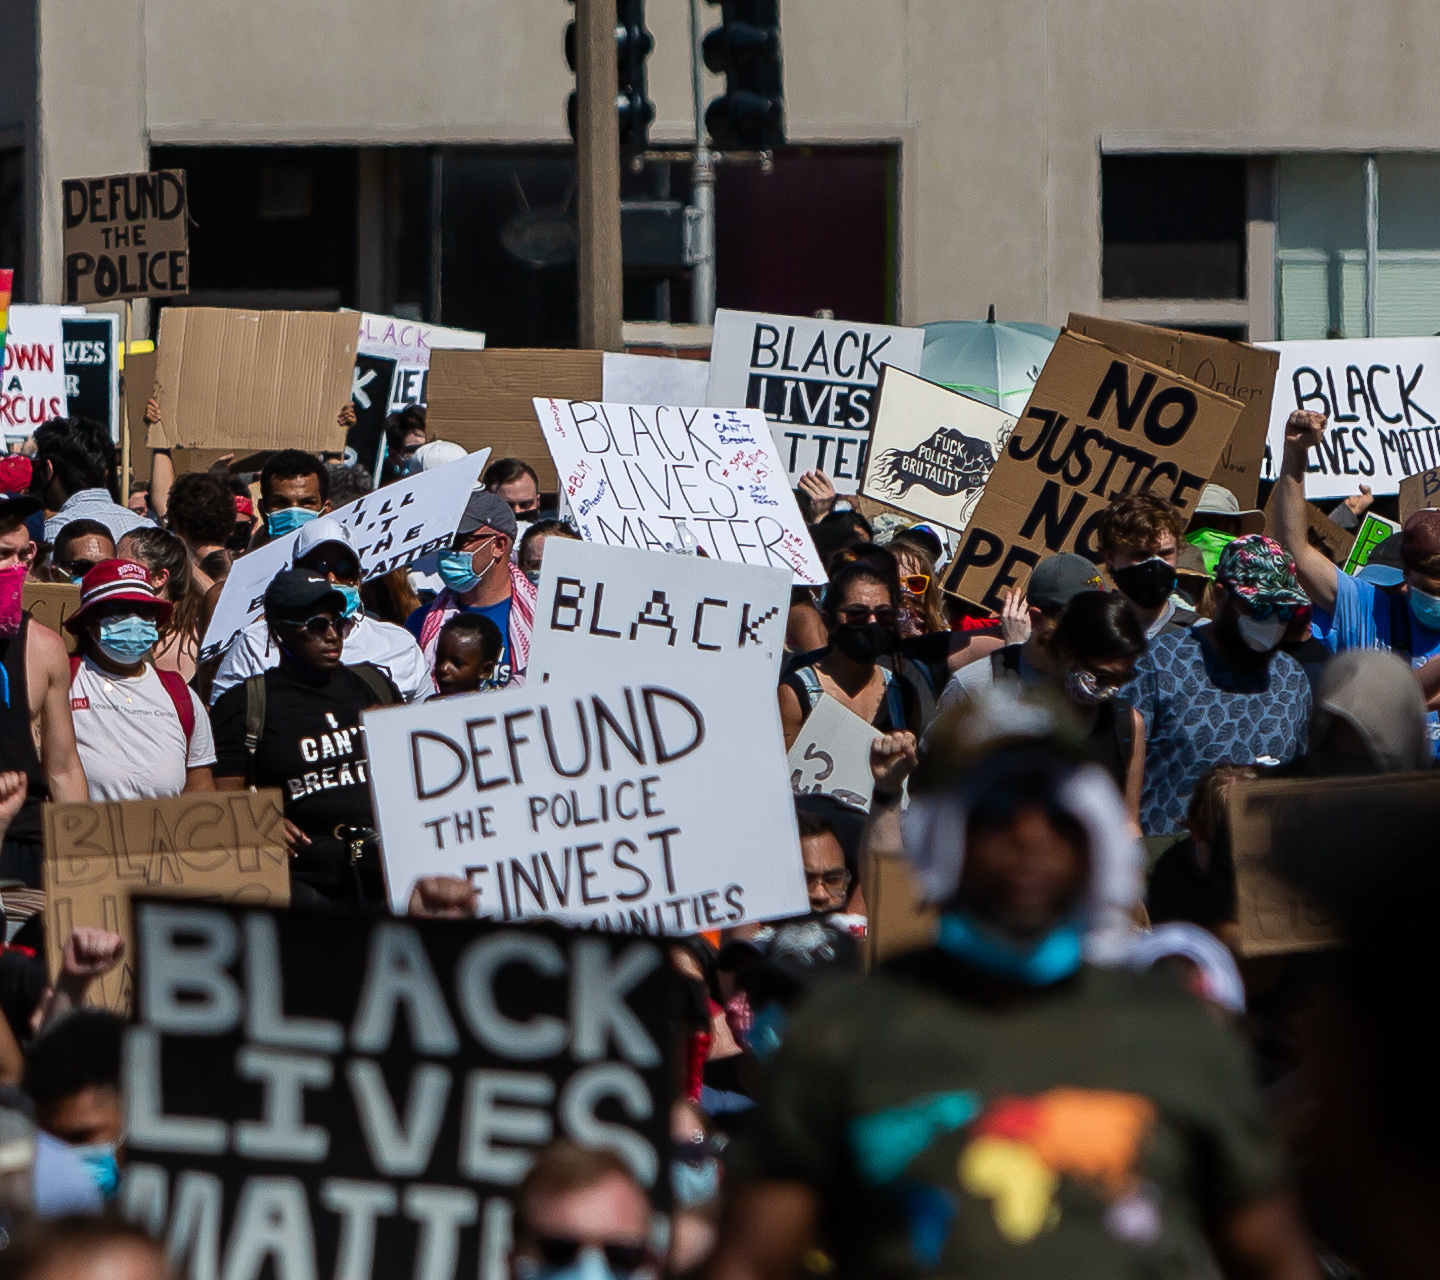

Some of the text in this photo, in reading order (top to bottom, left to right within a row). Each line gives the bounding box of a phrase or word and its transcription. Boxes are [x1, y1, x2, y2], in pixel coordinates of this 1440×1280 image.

[62, 171, 187, 230] DEFUND
[101, 224, 147, 250] THE
[66, 249, 188, 303] POLICE
[3, 343, 55, 372] OWN
[63, 340, 107, 365] VES
[357, 318, 432, 349] LACK
[749, 321, 892, 380] BLACK
[0, 394, 64, 427] RCUS
[757, 376, 870, 429] LIVES
[1086, 359, 1200, 448] NO
[1291, 363, 1437, 427] BLACK
[568, 400, 722, 462] BLACK
[784, 430, 868, 481] TTE
[916, 444, 956, 471] POLICE
[933, 432, 966, 458] FUCK
[1006, 405, 1212, 509] JUSTICE
[567, 458, 594, 497] #BLM
[600, 457, 739, 519] LIVES
[900, 453, 964, 492] BRUTALITY
[597, 514, 797, 573] MATTER
[1017, 479, 1108, 567] NO
[364, 531, 455, 582] ATTER
[549, 575, 781, 653] BLACK
[299, 724, 367, 763] CAN'
[409, 683, 708, 801] DEFUND
[286, 758, 368, 801] BREAT
[423, 774, 667, 851] THE POLICE
[50, 794, 289, 888] BLACK
[463, 825, 682, 921] EINVEST
[599, 883, 748, 936] UNITIES
[135, 900, 663, 1069] BLACK
[123, 1026, 662, 1189] LIVES
